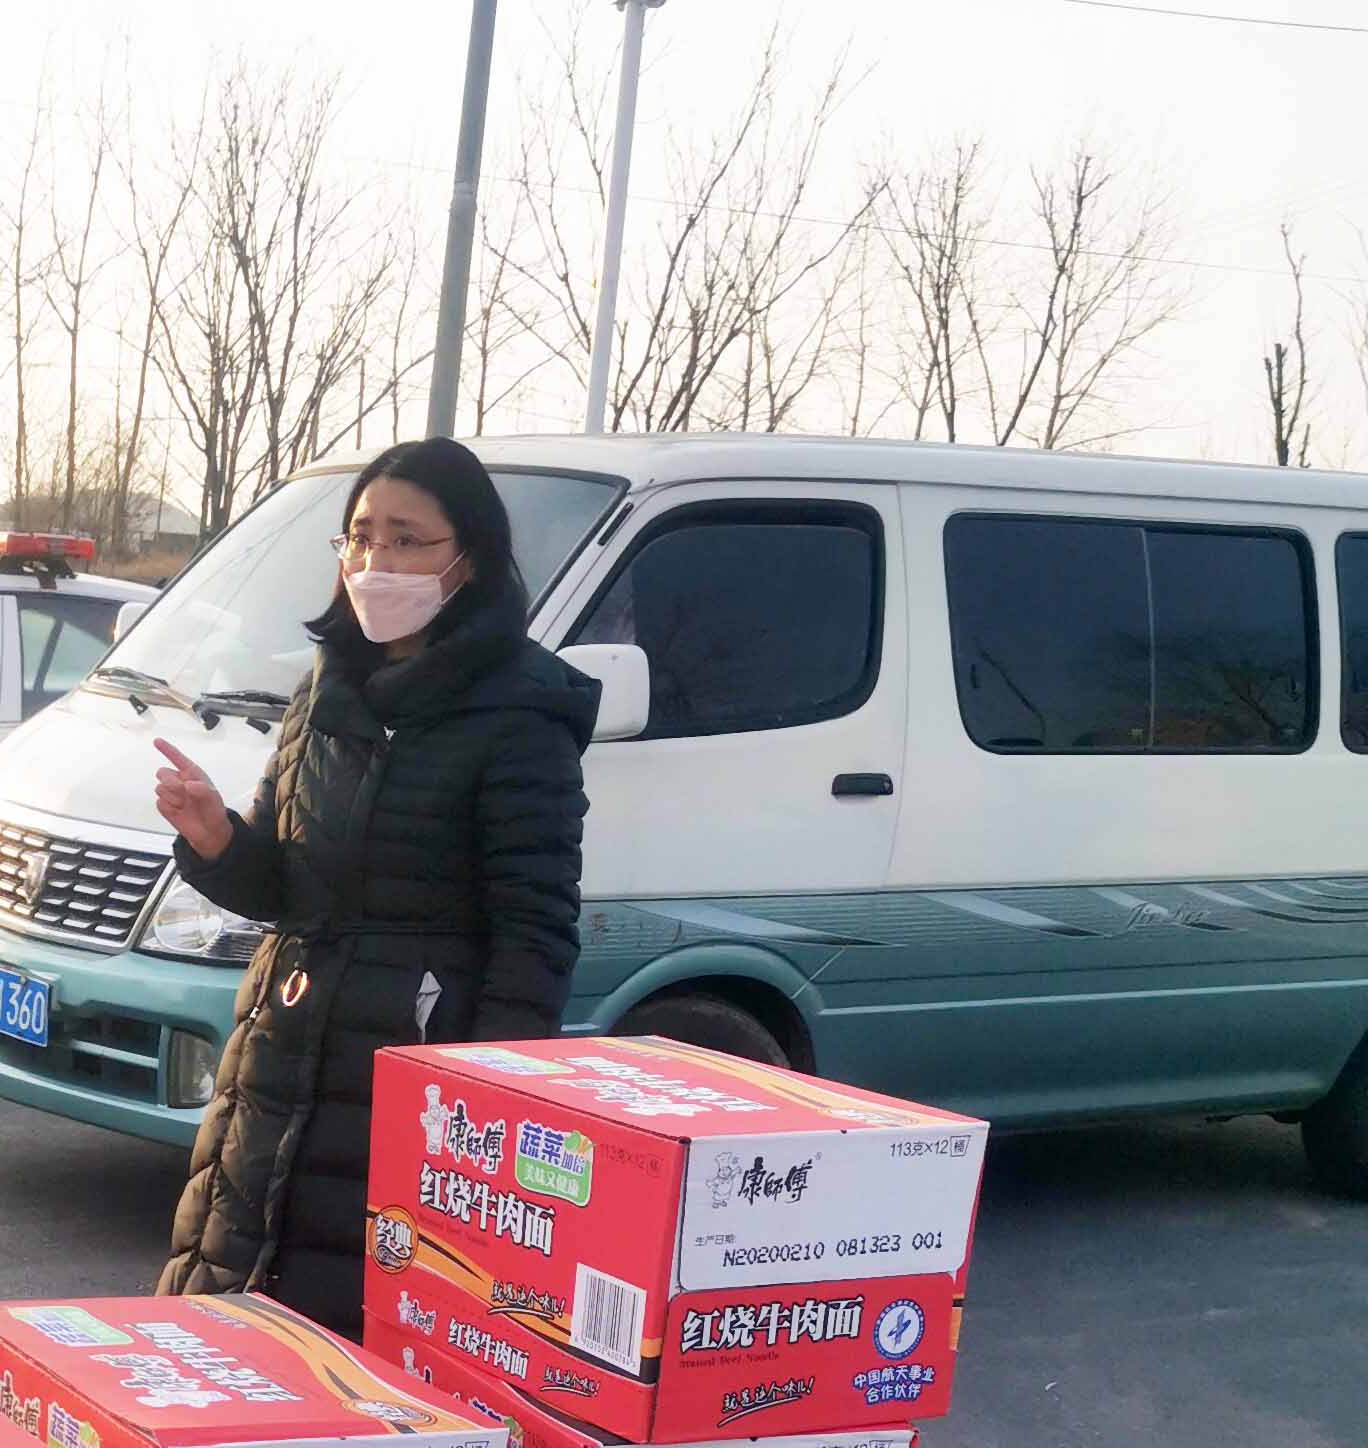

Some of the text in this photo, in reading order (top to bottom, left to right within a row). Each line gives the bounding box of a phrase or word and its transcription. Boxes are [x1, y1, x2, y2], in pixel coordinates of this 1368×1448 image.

[448, 1101, 506, 1173] 康師傅
[738, 1156, 812, 1205] 康師傅
[419, 1162, 555, 1256] 红烧牛肉面
[374, 1213, 412, 1257] 经典
[722, 1231, 943, 1268] N20200210 081323 001
[447, 1318, 530, 1380] 红烧牛肉面
[680, 1295, 865, 1354] 红烧牛肉面
[852, 1364, 935, 1391] 中国航天事业
[865, 1382, 921, 1406] 合作伙伴
